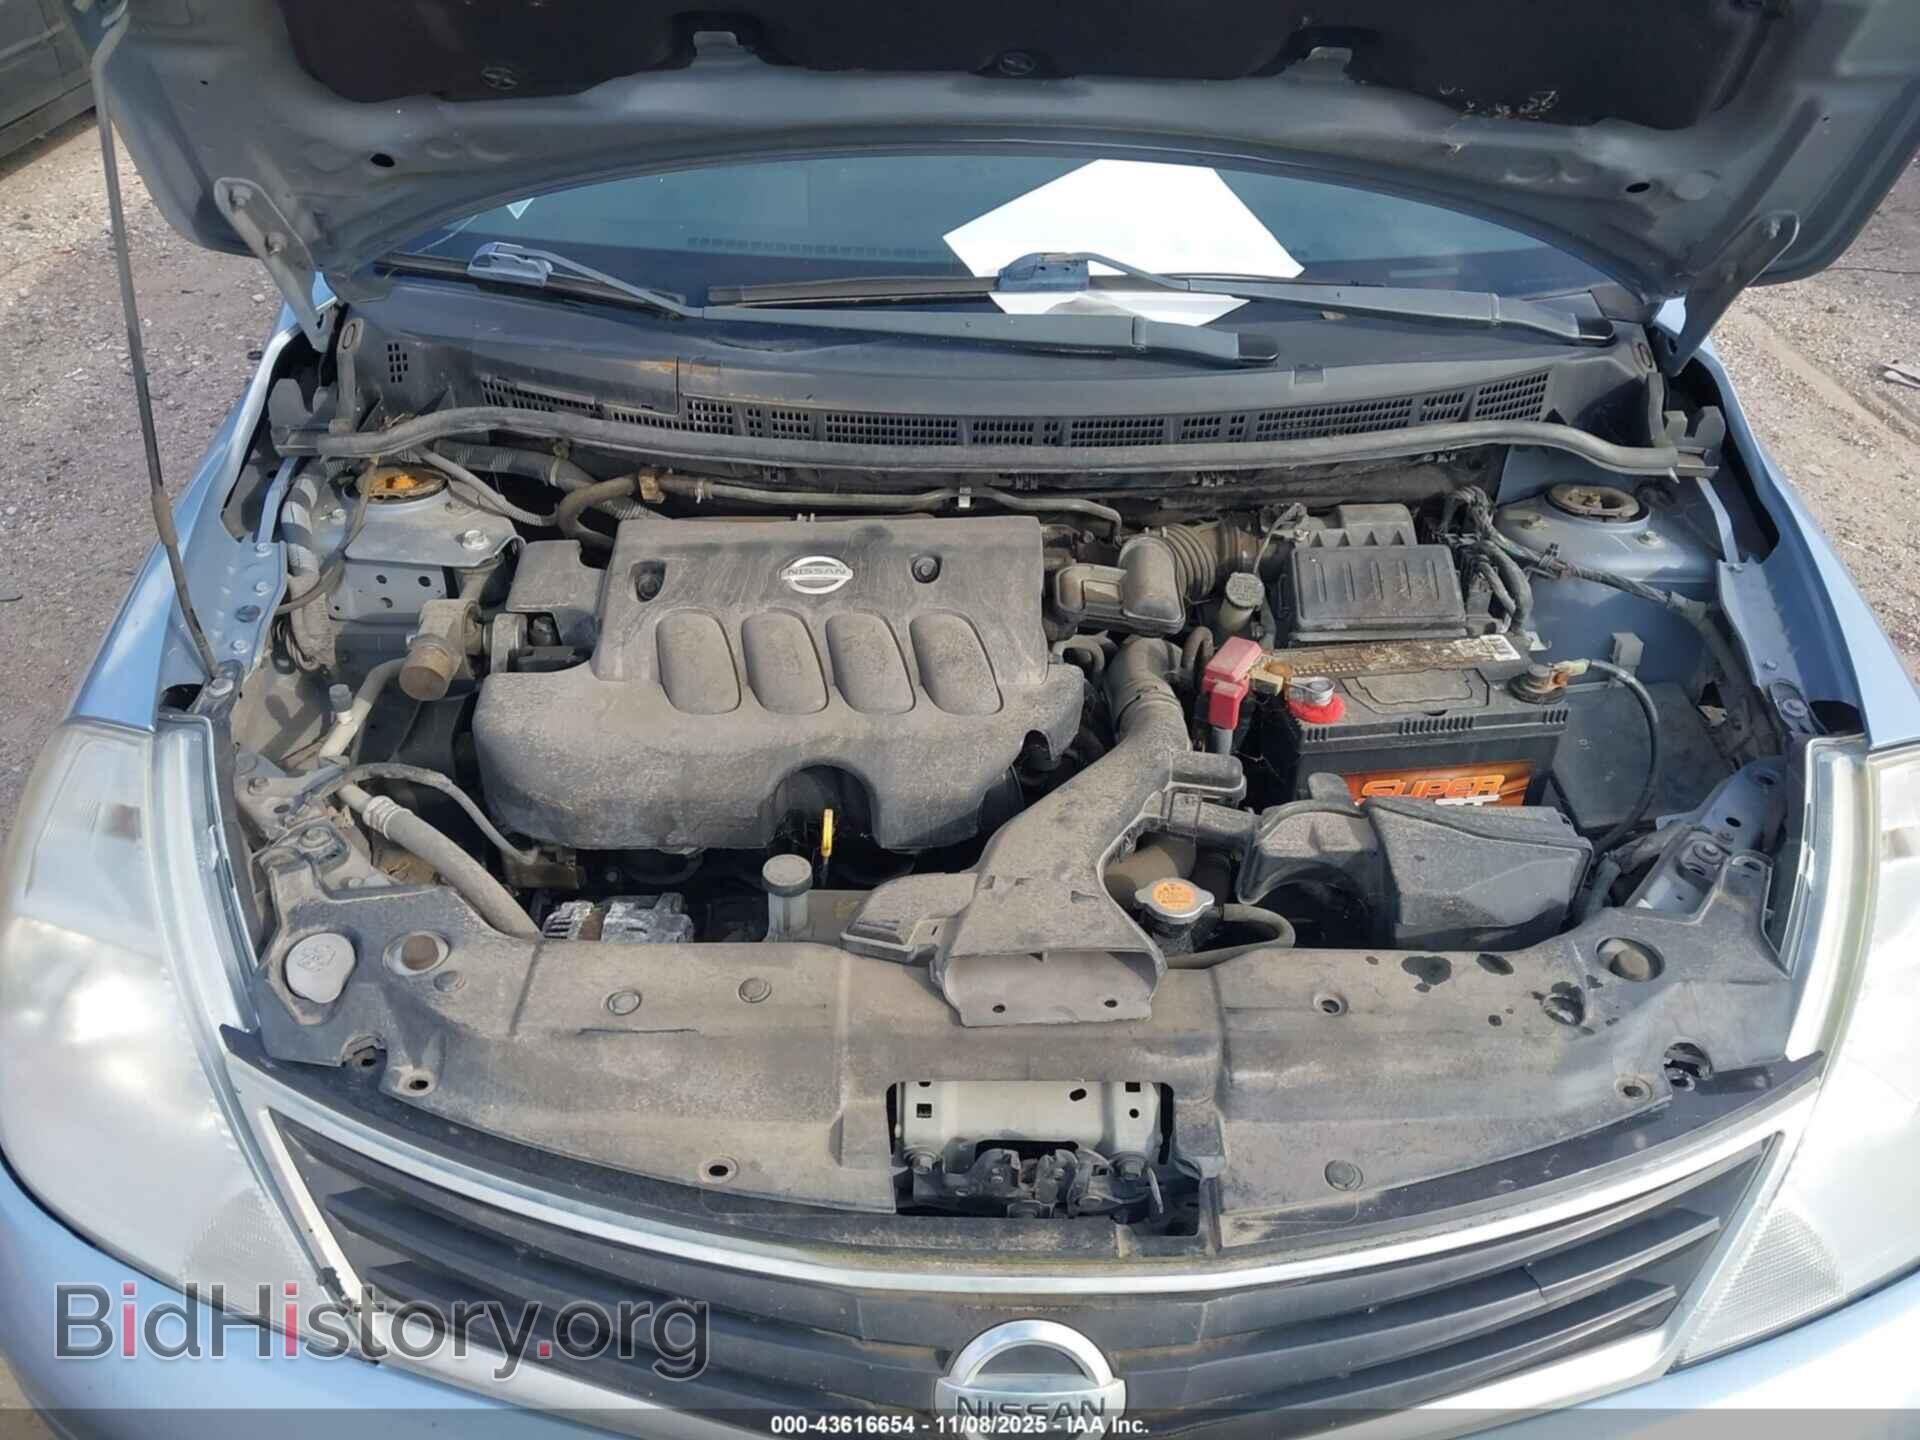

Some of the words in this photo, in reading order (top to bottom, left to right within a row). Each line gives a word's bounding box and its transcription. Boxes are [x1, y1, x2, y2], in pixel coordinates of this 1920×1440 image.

[787, 567, 847, 576] NISSAN
[1361, 774, 1506, 800] SUPER
[957, 1395, 1106, 1423] NISSAN
